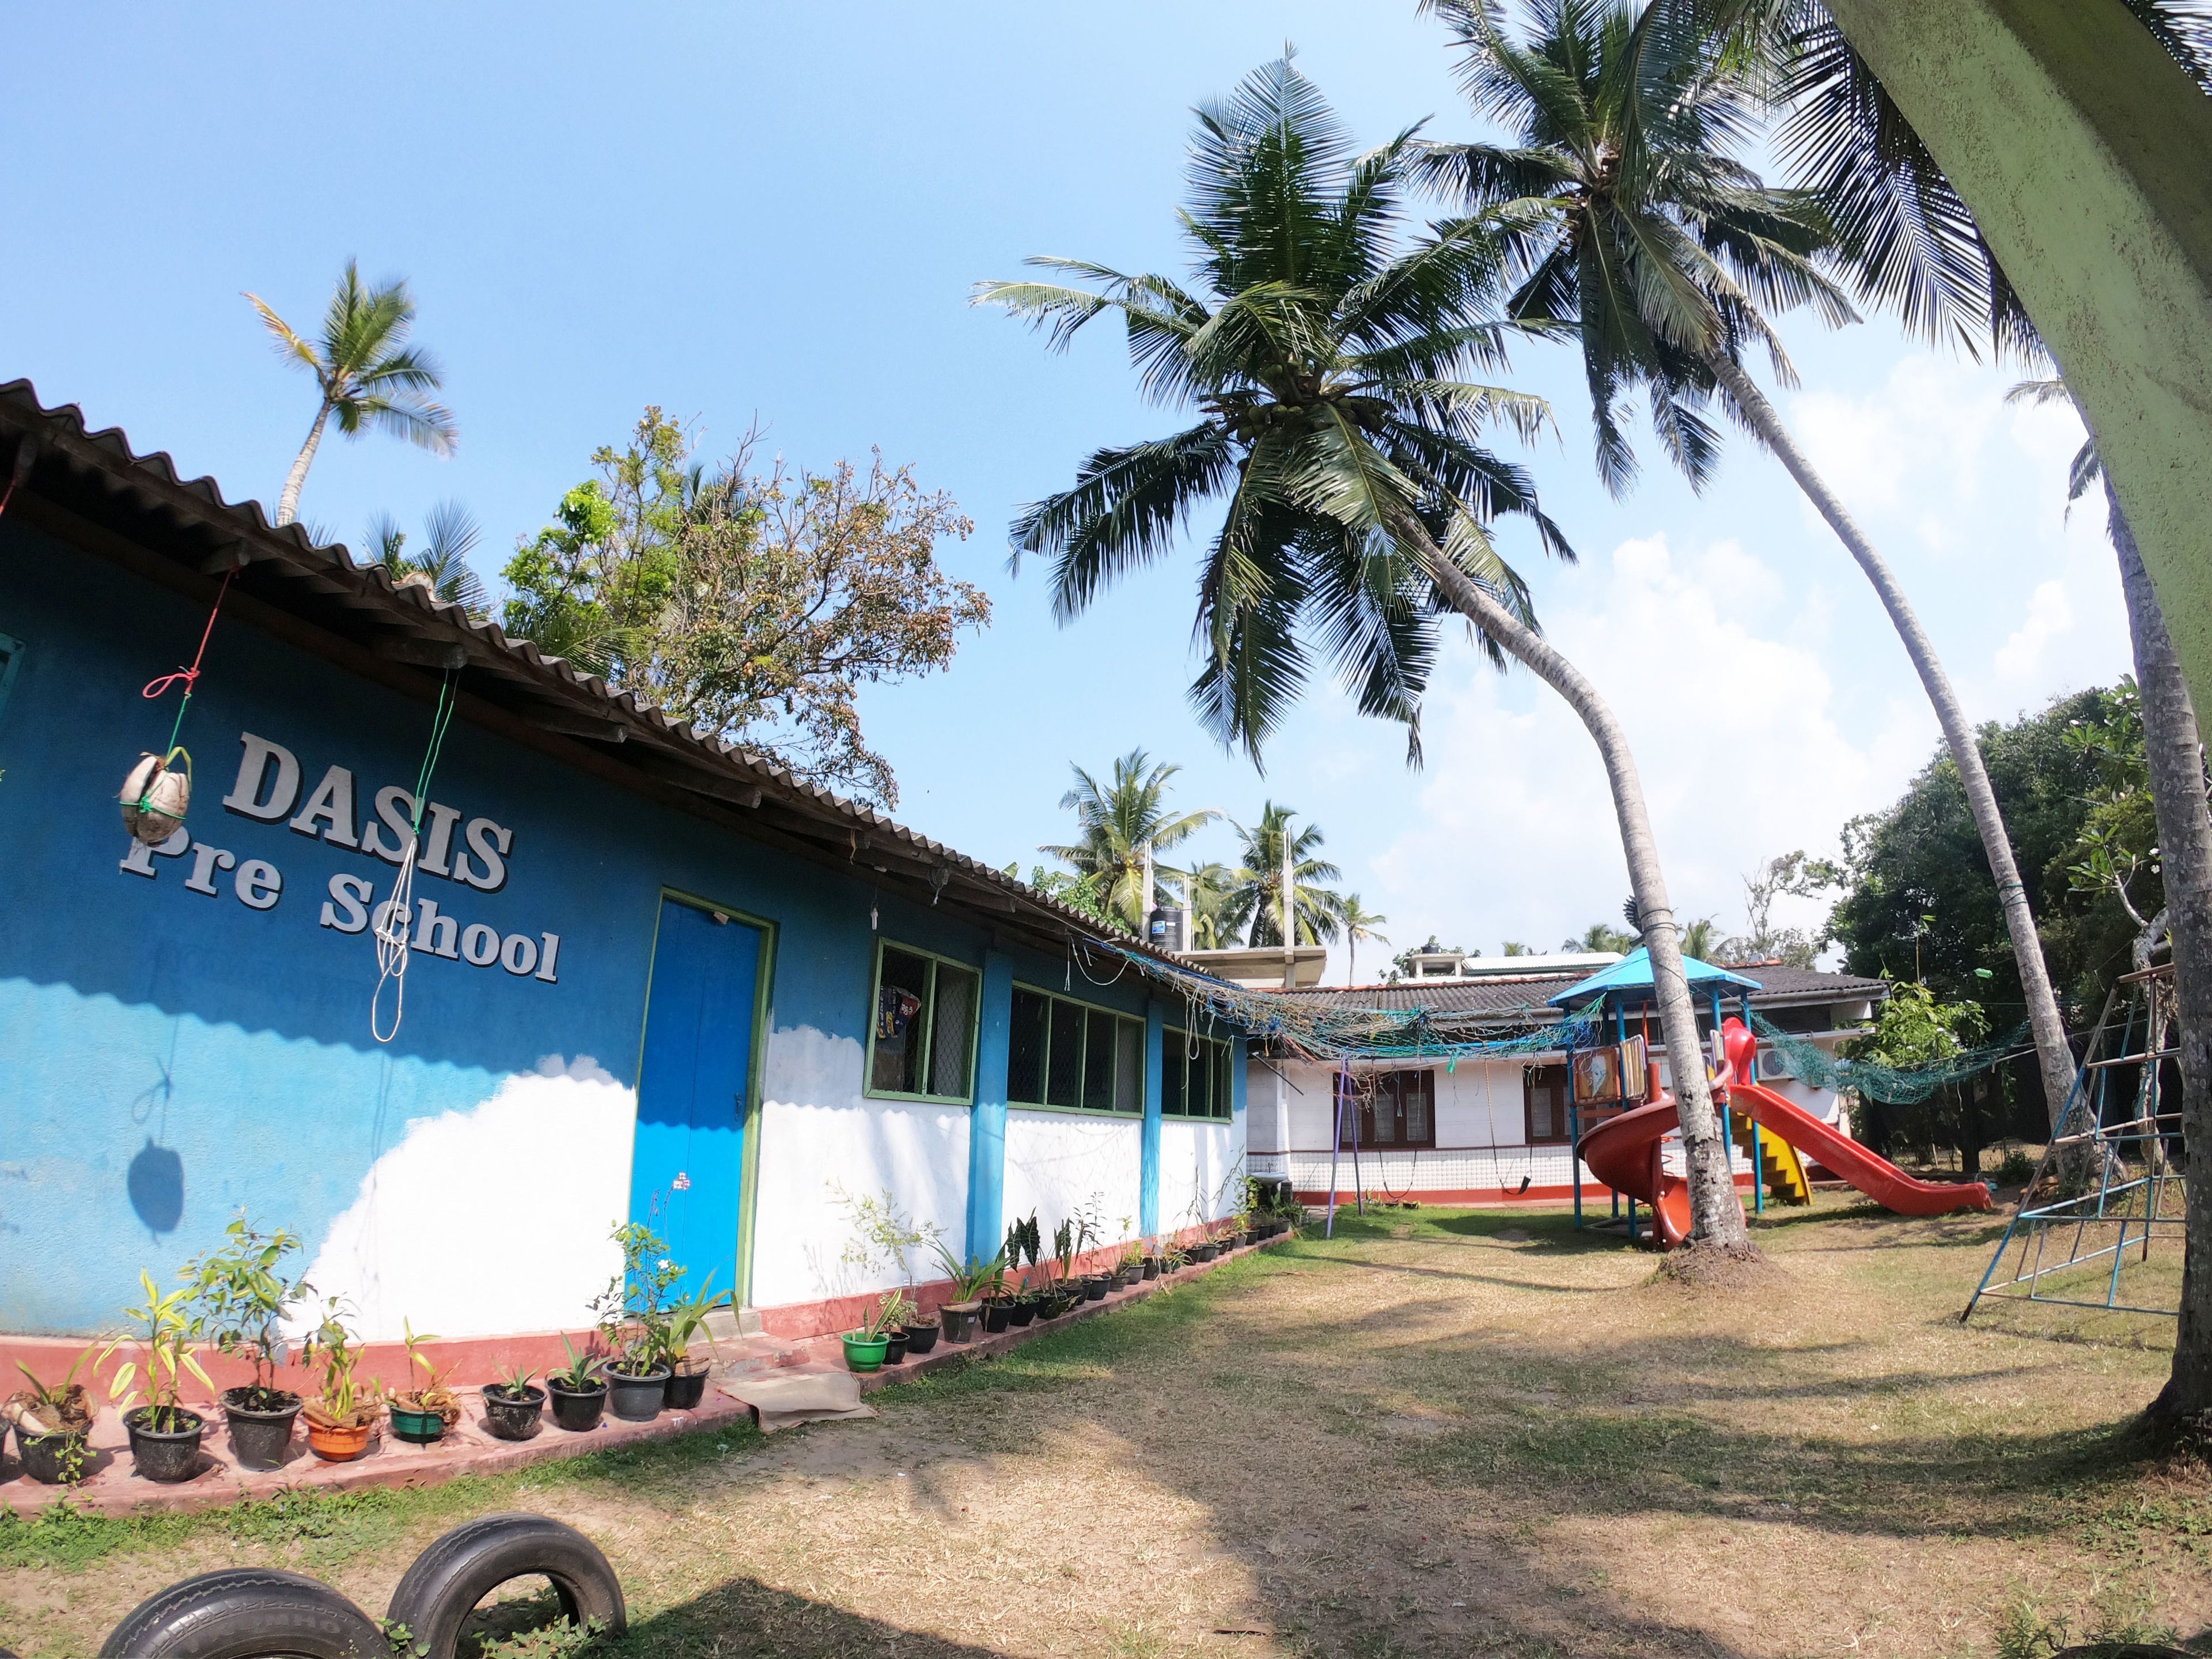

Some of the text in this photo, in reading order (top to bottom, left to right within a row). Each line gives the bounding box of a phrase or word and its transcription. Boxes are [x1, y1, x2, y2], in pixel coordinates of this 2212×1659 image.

[224, 731, 512, 889] DASIS
[120, 826, 560, 982] Pre School
